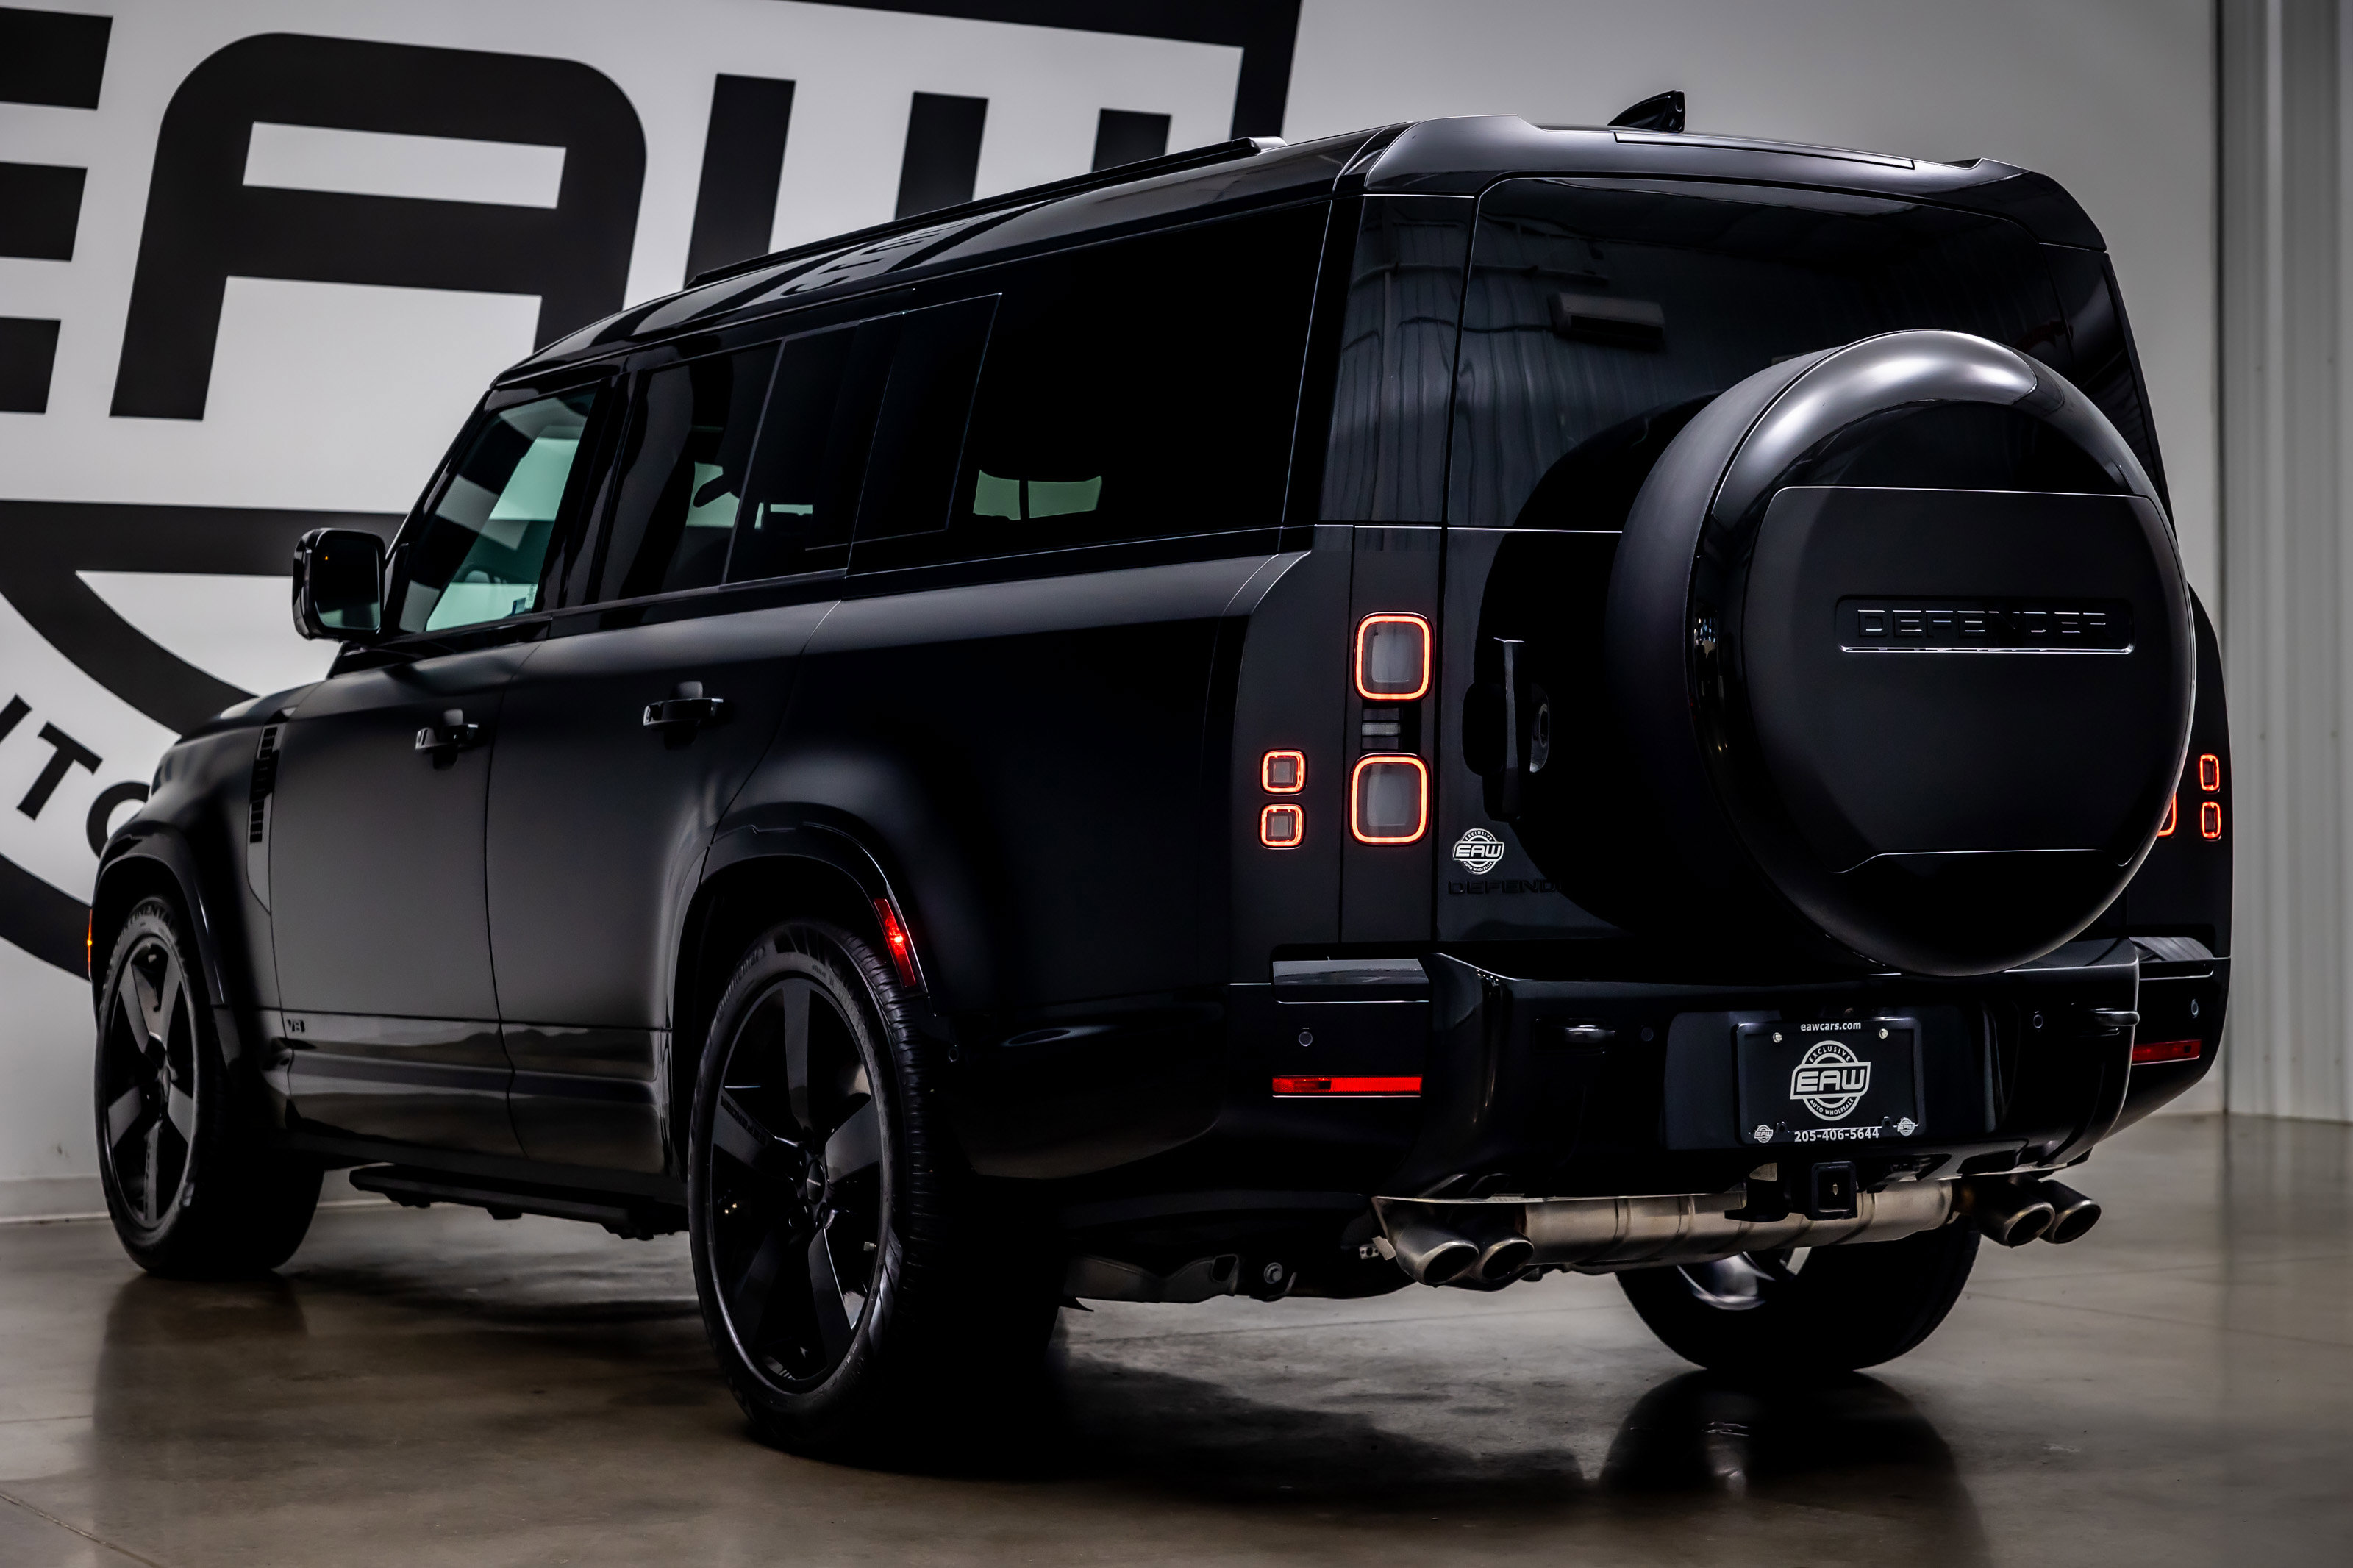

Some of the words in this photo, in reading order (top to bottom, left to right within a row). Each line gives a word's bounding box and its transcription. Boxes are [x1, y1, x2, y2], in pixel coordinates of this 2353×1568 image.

[1857, 609, 2107, 638] DEFENDER
[1465, 831, 1493, 840] EXCLUSIVE
[1455, 845, 1502, 857] EAW
[1800, 1021, 1862, 1032] eawcars.com
[1808, 1045, 1851, 1063] EXCLUSIVE
[1796, 1069, 1865, 1092] EAW
[1810, 1099, 1824, 1113] AUTO
[1825, 1098, 1854, 1116] WHOLESALE
[1794, 1128, 1879, 1142] 205-406-5644
